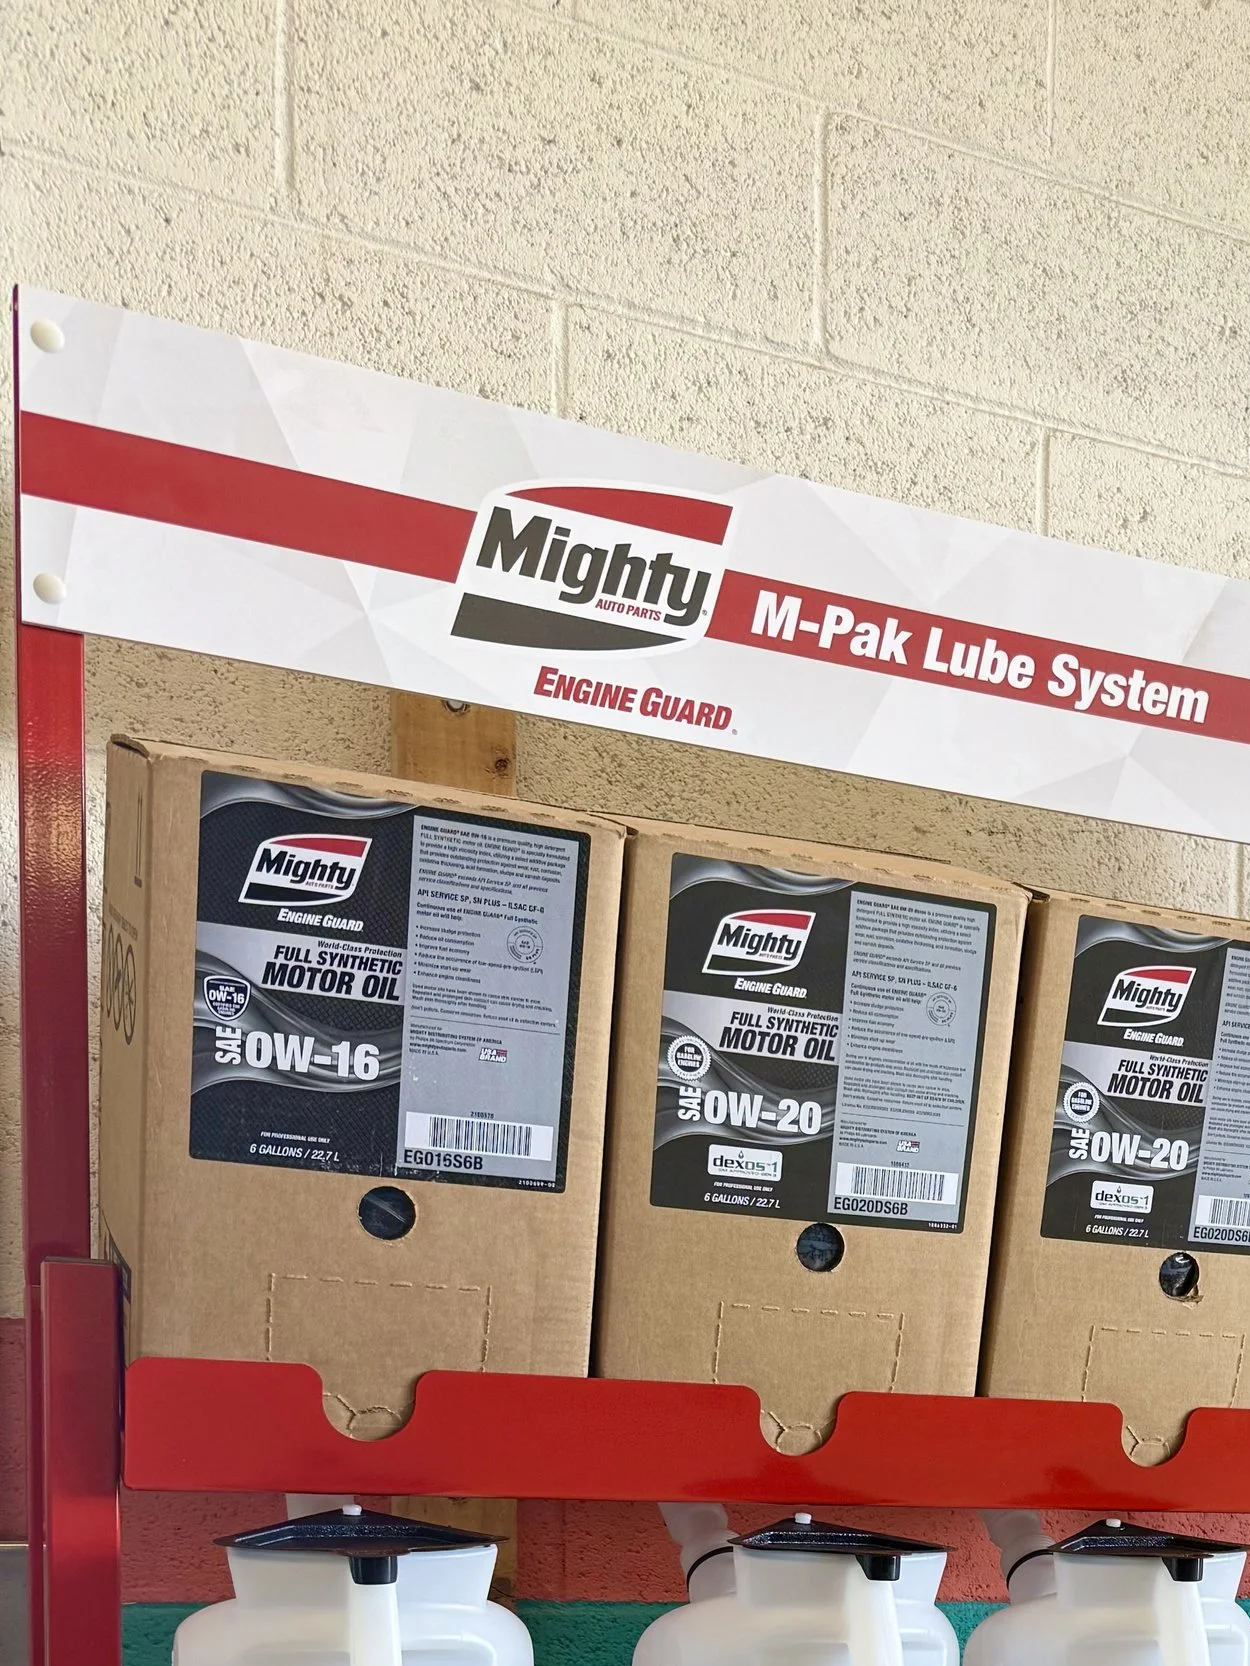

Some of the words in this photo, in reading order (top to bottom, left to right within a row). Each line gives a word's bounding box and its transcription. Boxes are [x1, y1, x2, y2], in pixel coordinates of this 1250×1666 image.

[478, 507, 709, 627] Mighty
[595, 599, 625, 614] AUTO
[627, 604, 662, 622] PARTS
[751, 589, 912, 667] M-Pak
[923, 627, 1035, 689] Lube
[1047, 654, 1209, 724] System
[534, 666, 634, 711] ENGINE
[639, 686, 733, 730] GUARD
[255, 848, 355, 889] Mighty
[418, 889, 428, 897] API
[431, 892, 458, 901] SERVICE
[278, 909, 321, 927] ENGINE
[323, 914, 363, 932] GUARD
[318, 940, 362, 954] World-Class
[364, 946, 402, 958] Protection
[717, 923, 801, 959] Mighty
[274, 945, 312, 962] FULL
[316, 950, 403, 975] SYNTHETIC
[219, 984, 235, 992] SAE
[262, 962, 355, 994] MOTOR
[362, 974, 400, 1001] OIL
[734, 978, 771, 993] ENGINE
[773, 982, 807, 998] GUARD
[208, 989, 245, 1004] 0W-16
[1112, 979, 1183, 1012] Mighty
[730, 1012, 762, 1028] FULL
[766, 1016, 839, 1038] SYNTHETIC
[768, 1007, 805, 1018] World-Class
[807, 1012, 839, 1022] Protection
[719, 1028, 797, 1057] MOTOR
[804, 1037, 835, 1061] OIL
[1124, 1029, 1155, 1043] ENGINE
[1155, 1033, 1184, 1047] GUARD
[215, 1027, 242, 1064] SAE
[245, 1030, 380, 1080] 0W-16
[1118, 1060, 1144, 1075] FULL
[1148, 1064, 1208, 1083] SYNTHETIC
[1107, 1075, 1172, 1099] MOTOR
[1178, 1083, 1203, 1102] OIL
[678, 1086, 701, 1121] SAE
[704, 1090, 822, 1135] 0W-20
[250, 1143, 256, 1153] 6
[258, 1145, 302, 1158] GALLONS
[311, 1149, 332, 1160] 22.7
[334, 1152, 339, 1162] L
[1069, 1128, 1090, 1159] SAE
[1091, 1132, 1189, 1170] 0W-20
[704, 1193, 709, 1202] 6
[712, 1194, 749, 1206] GALLONS
[756, 1197, 775, 1208] 22.7
[776, 1200, 780, 1208] L
[834, 1197, 908, 1215] EG020DS6B
